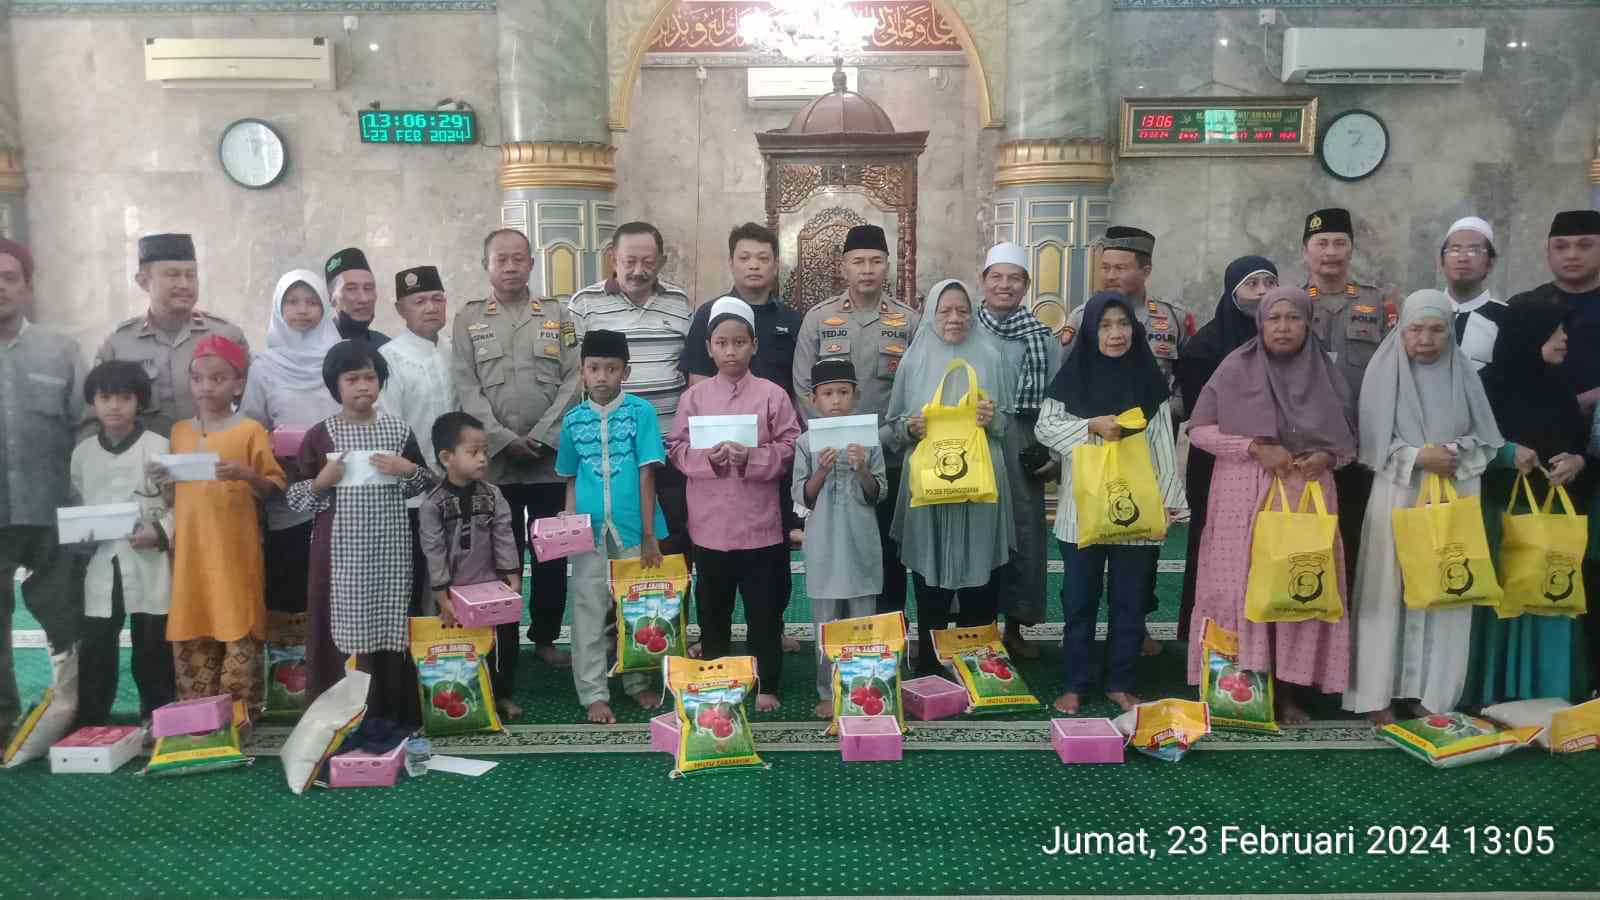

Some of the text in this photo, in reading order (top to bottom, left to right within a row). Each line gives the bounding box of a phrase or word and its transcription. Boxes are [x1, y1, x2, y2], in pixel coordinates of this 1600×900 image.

[367, 113, 463, 128] 13:06:29
[370, 130, 465, 142] 23 FEB 2024
[822, 330, 848, 338] TEDJO
